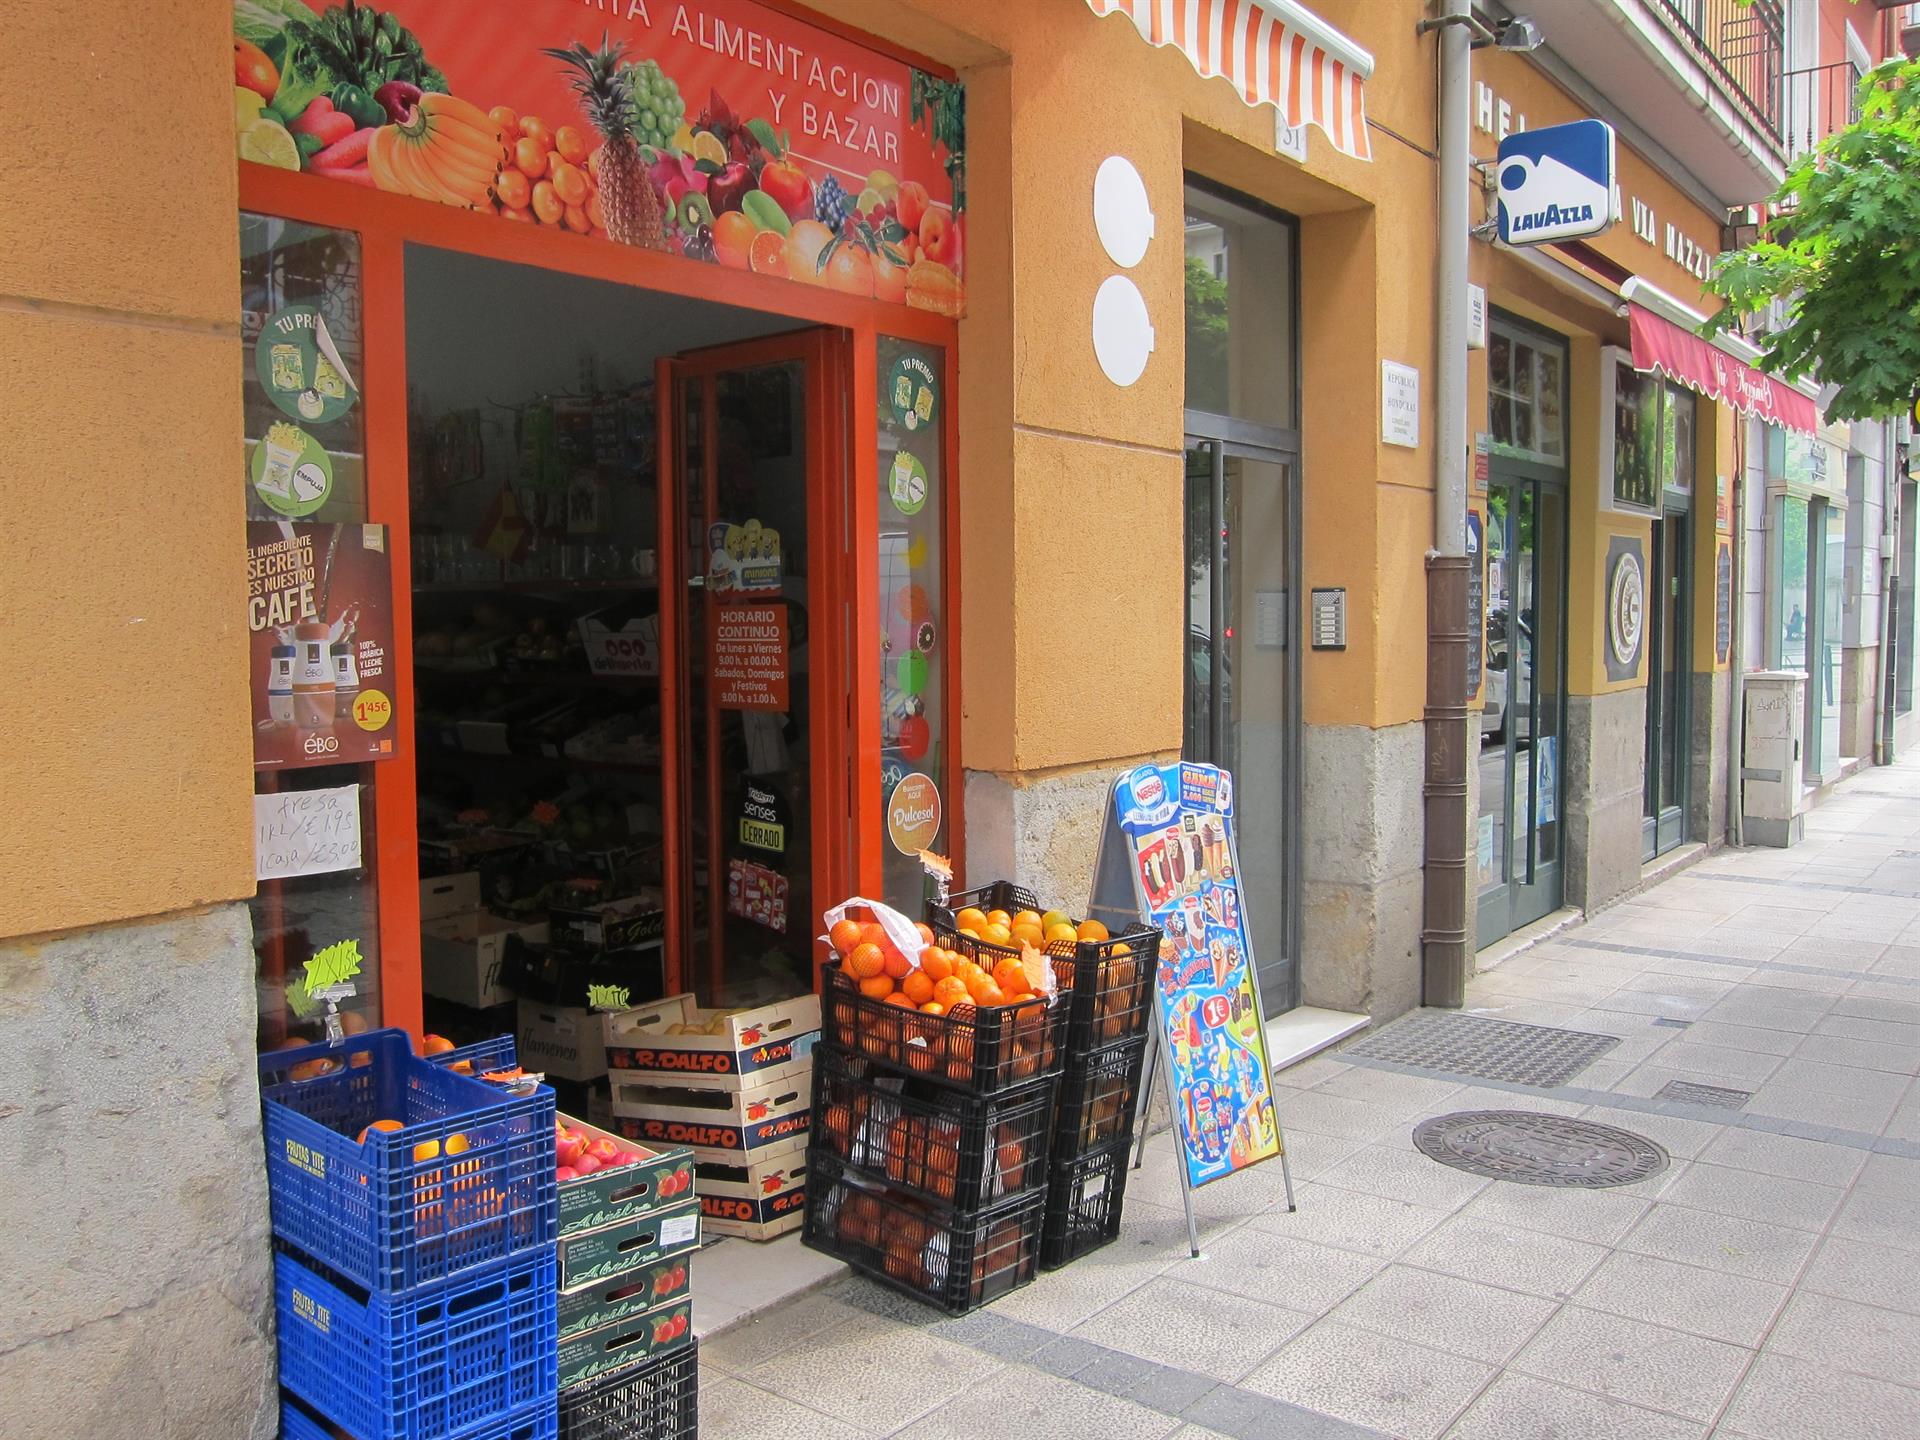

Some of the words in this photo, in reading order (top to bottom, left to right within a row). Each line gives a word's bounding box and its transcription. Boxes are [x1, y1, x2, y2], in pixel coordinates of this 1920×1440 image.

[671, 4, 899, 118] ALIMENTACION
[768, 89, 786, 125] Y
[802, 101, 899, 164] BAZAR
[1512, 203, 1593, 233] LAVAZZA
[1632, 196, 1656, 247] VIA
[274, 315, 294, 334] TU
[294, 313, 318, 330] PRE
[902, 358, 911, 371] TU
[911, 358, 934, 384] PREMIO
[296, 470, 325, 493] EMPUJA
[257, 534, 312, 556] INGREDIENTE
[248, 546, 314, 579] SECRETO
[248, 579, 262, 596] ES
[264, 567, 315, 593] NUESTRO
[250, 581, 317, 632] CAFÉ
[720, 611, 775, 623] HORARIO
[718, 626, 779, 638] CONTINUO
[359, 640, 376, 650] 100%
[716, 643, 726, 653] De
[727, 643, 747, 653] lunes
[748, 645, 753, 653] a
[753, 643, 782, 654] Viernes
[360, 661, 365, 669] Y
[364, 658, 383, 668] LECHE
[718, 655, 735, 665] 9.00
[744, 657, 749, 665] a
[750, 655, 771, 666] 00.00
[360, 669, 383, 679] FRESCA
[747, 668, 785, 681] Domingos
[731, 683, 736, 692] y
[736, 681, 767, 691] Festivos
[747, 695, 752, 703] a
[1136, 780, 1162, 801] Nestlé
[277, 794, 337, 818] fresa
[744, 801, 777, 823] senses
[893, 804, 934, 827] Dulcesol
[742, 820, 780, 848] CERRADO
[635, 1049, 730, 1073] R.DALFO
[645, 1119, 737, 1145] R.DALFO
[287, 1139, 310, 1164] FRUTAS
[311, 1150, 325, 1172] TITE
